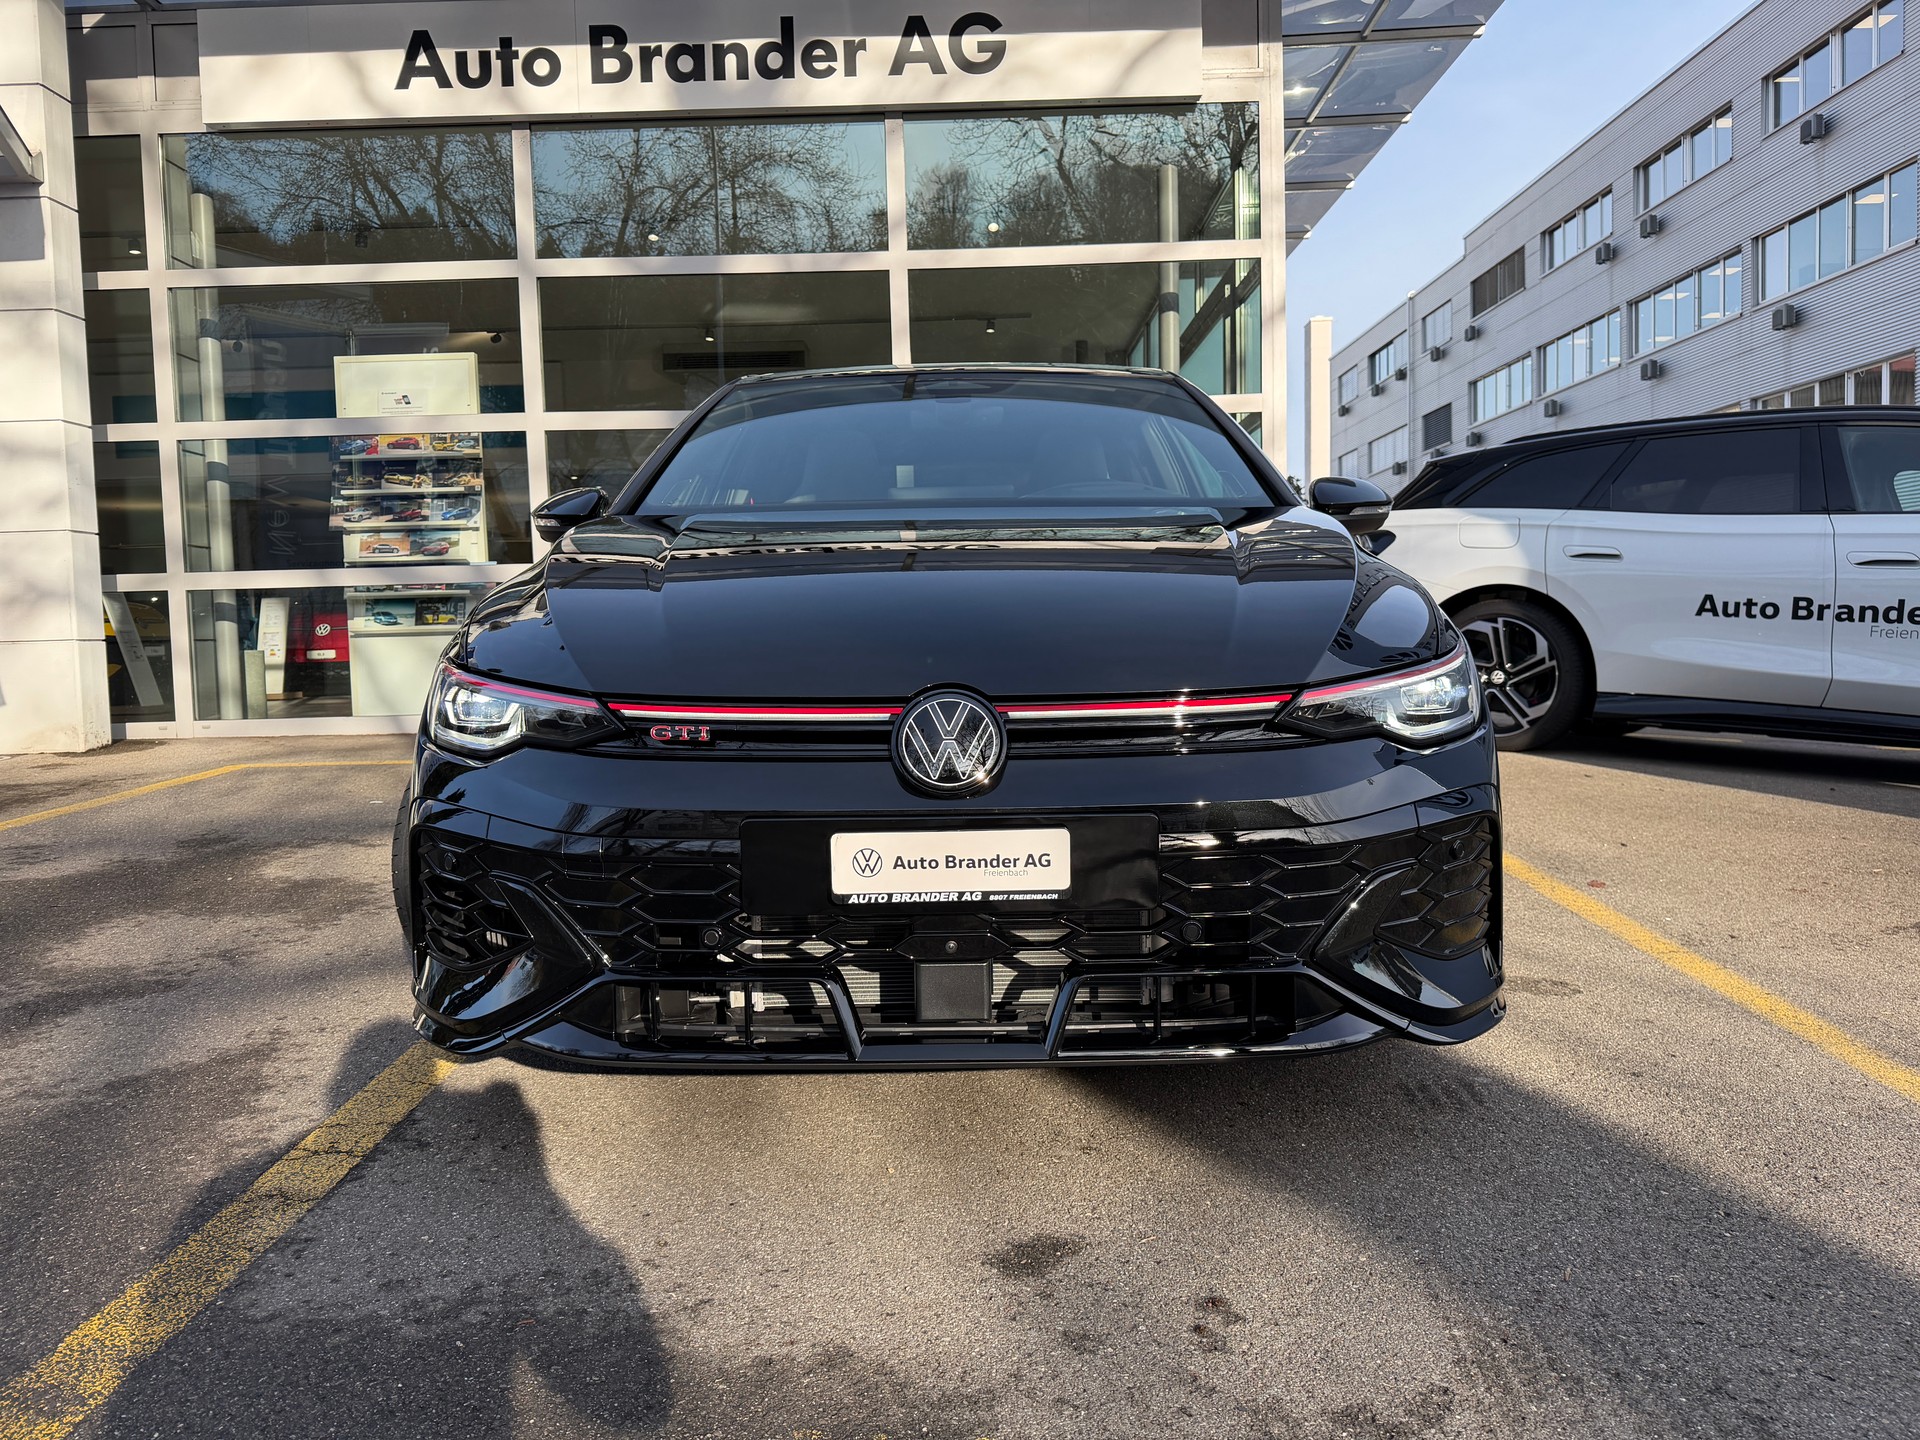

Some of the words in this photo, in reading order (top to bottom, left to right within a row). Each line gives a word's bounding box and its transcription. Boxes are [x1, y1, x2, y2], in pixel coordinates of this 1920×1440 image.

[394, 29, 562, 91] Auto
[588, 16, 867, 84] Brander
[888, 12, 1008, 77] AG
[1695, 594, 1780, 620] Auto
[1791, 596, 1920, 625] Brande
[1869, 625, 1920, 640] Freien
[650, 725, 711, 742] GTI
[892, 856, 939, 870] Auto
[945, 853, 1019, 869] Brander
[1024, 853, 1051, 867] AG
[984, 869, 1029, 877] Freienbach
[848, 893, 888, 904] AUTO
[891, 891, 958, 902] BRANDER
[961, 891, 982, 901] AG
